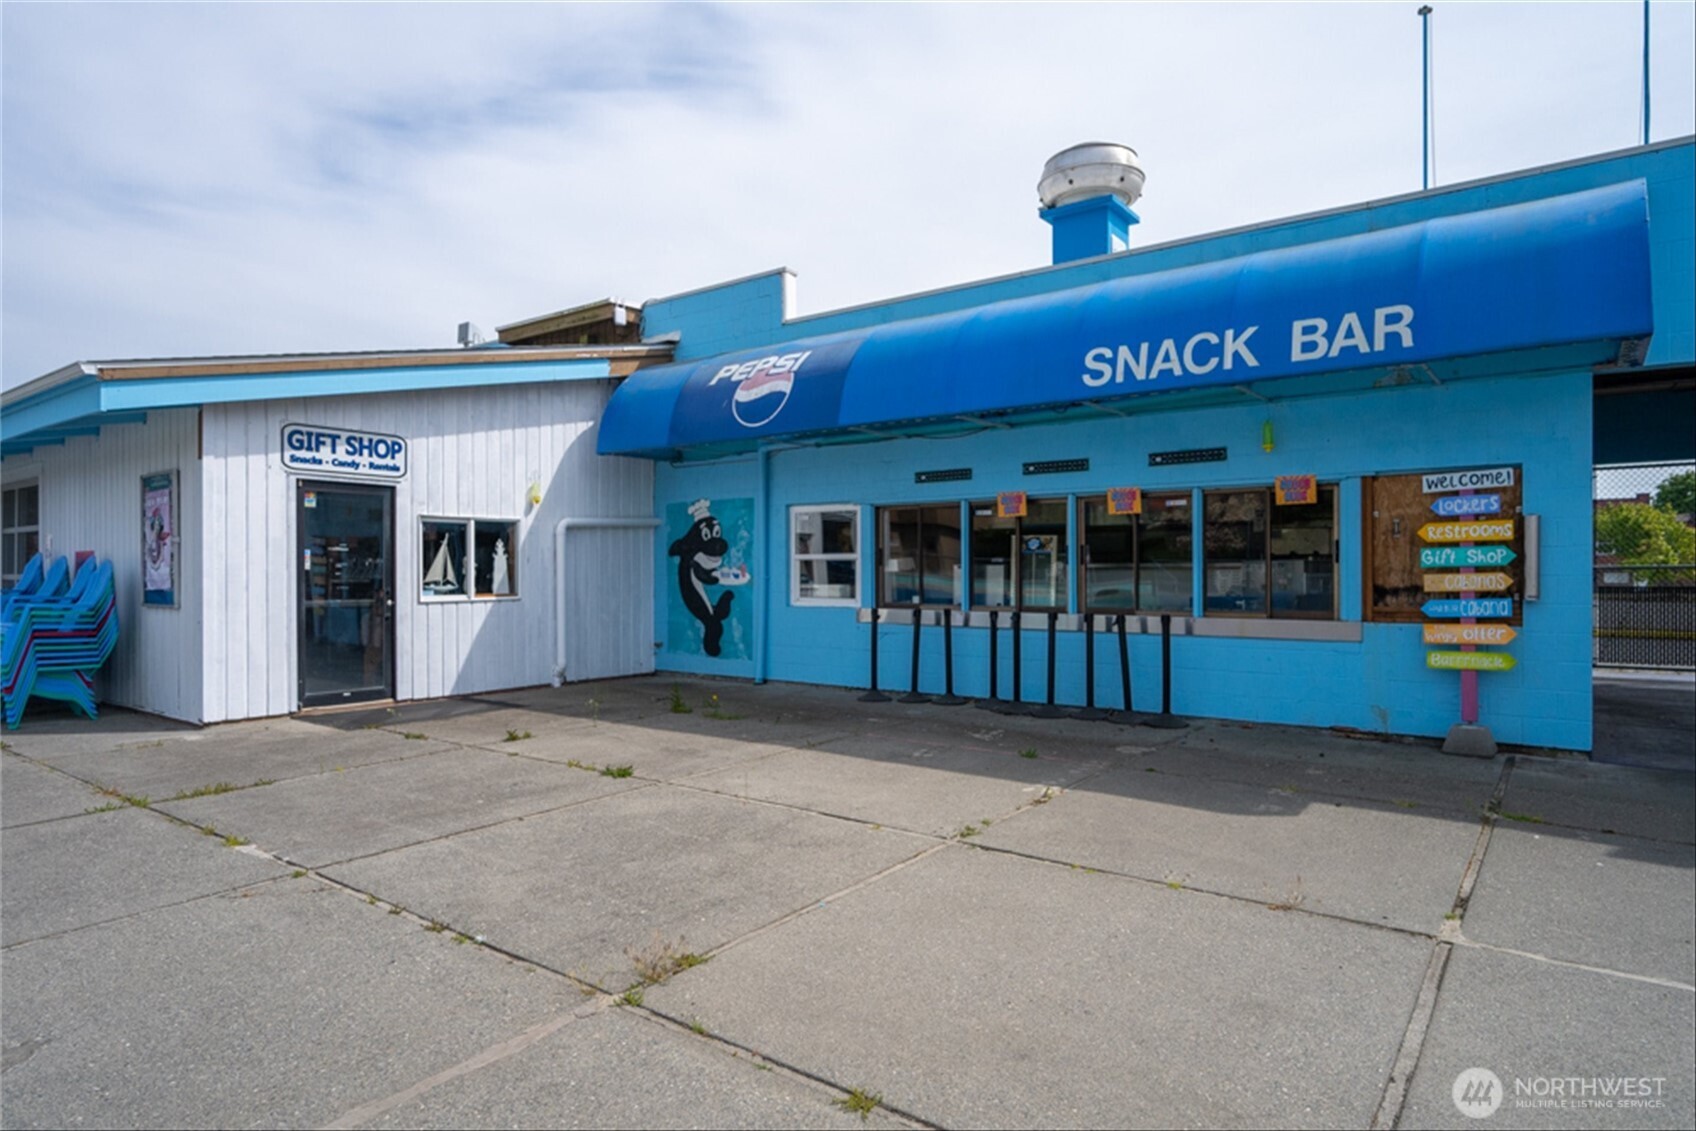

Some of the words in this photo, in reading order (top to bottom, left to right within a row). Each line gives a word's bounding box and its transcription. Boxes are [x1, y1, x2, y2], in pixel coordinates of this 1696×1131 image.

[1081, 325, 1260, 388] SNACK
[1290, 303, 1416, 363] BAR
[707, 350, 812, 387] PEPSI
[287, 429, 342, 455] GIFT
[345, 435, 403, 460] SHOP
[289, 453, 323, 466] Snacks
[331, 458, 361, 470] Candy
[368, 461, 401, 472] Rentals
[1421, 548, 1456, 565] Gift
